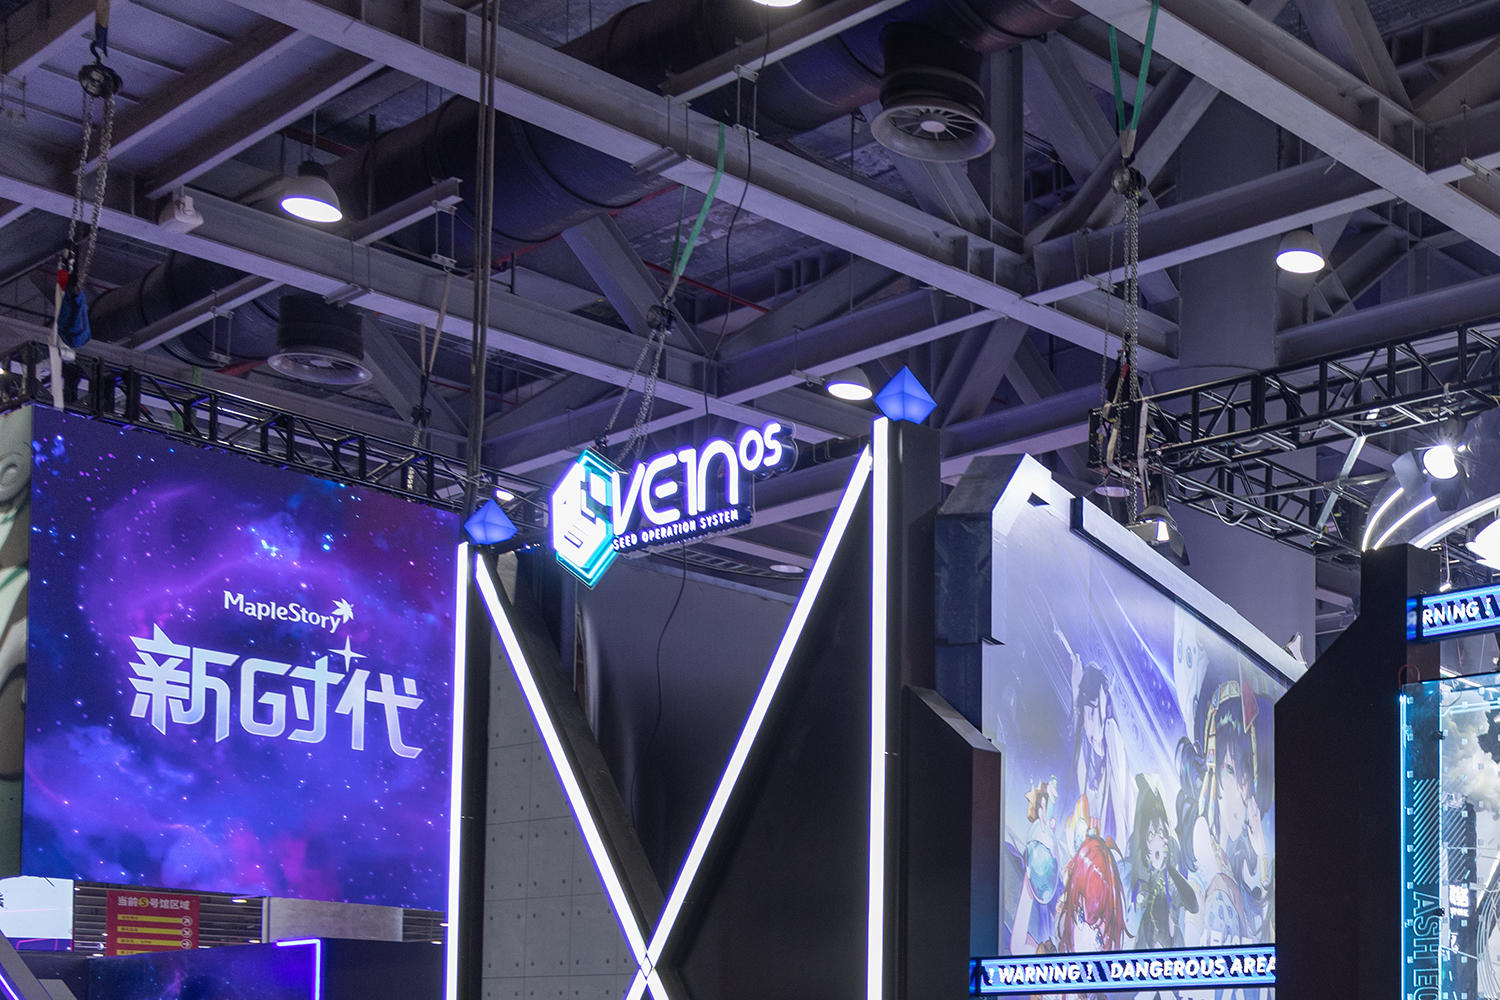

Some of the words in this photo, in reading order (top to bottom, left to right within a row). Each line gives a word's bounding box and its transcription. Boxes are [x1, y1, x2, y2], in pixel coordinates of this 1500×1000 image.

[612, 533, 638, 551] SEED
[642, 520, 697, 542] OPERATION
[699, 508, 739, 530] SYSTEM
[224, 590, 341, 633] MapleStory
[128, 622, 424, 759] 新时代
[1413, 891, 1440, 960] ASH
[998, 964, 1081, 984] WARNING
[1111, 958, 1226, 979] DANGEROUS
